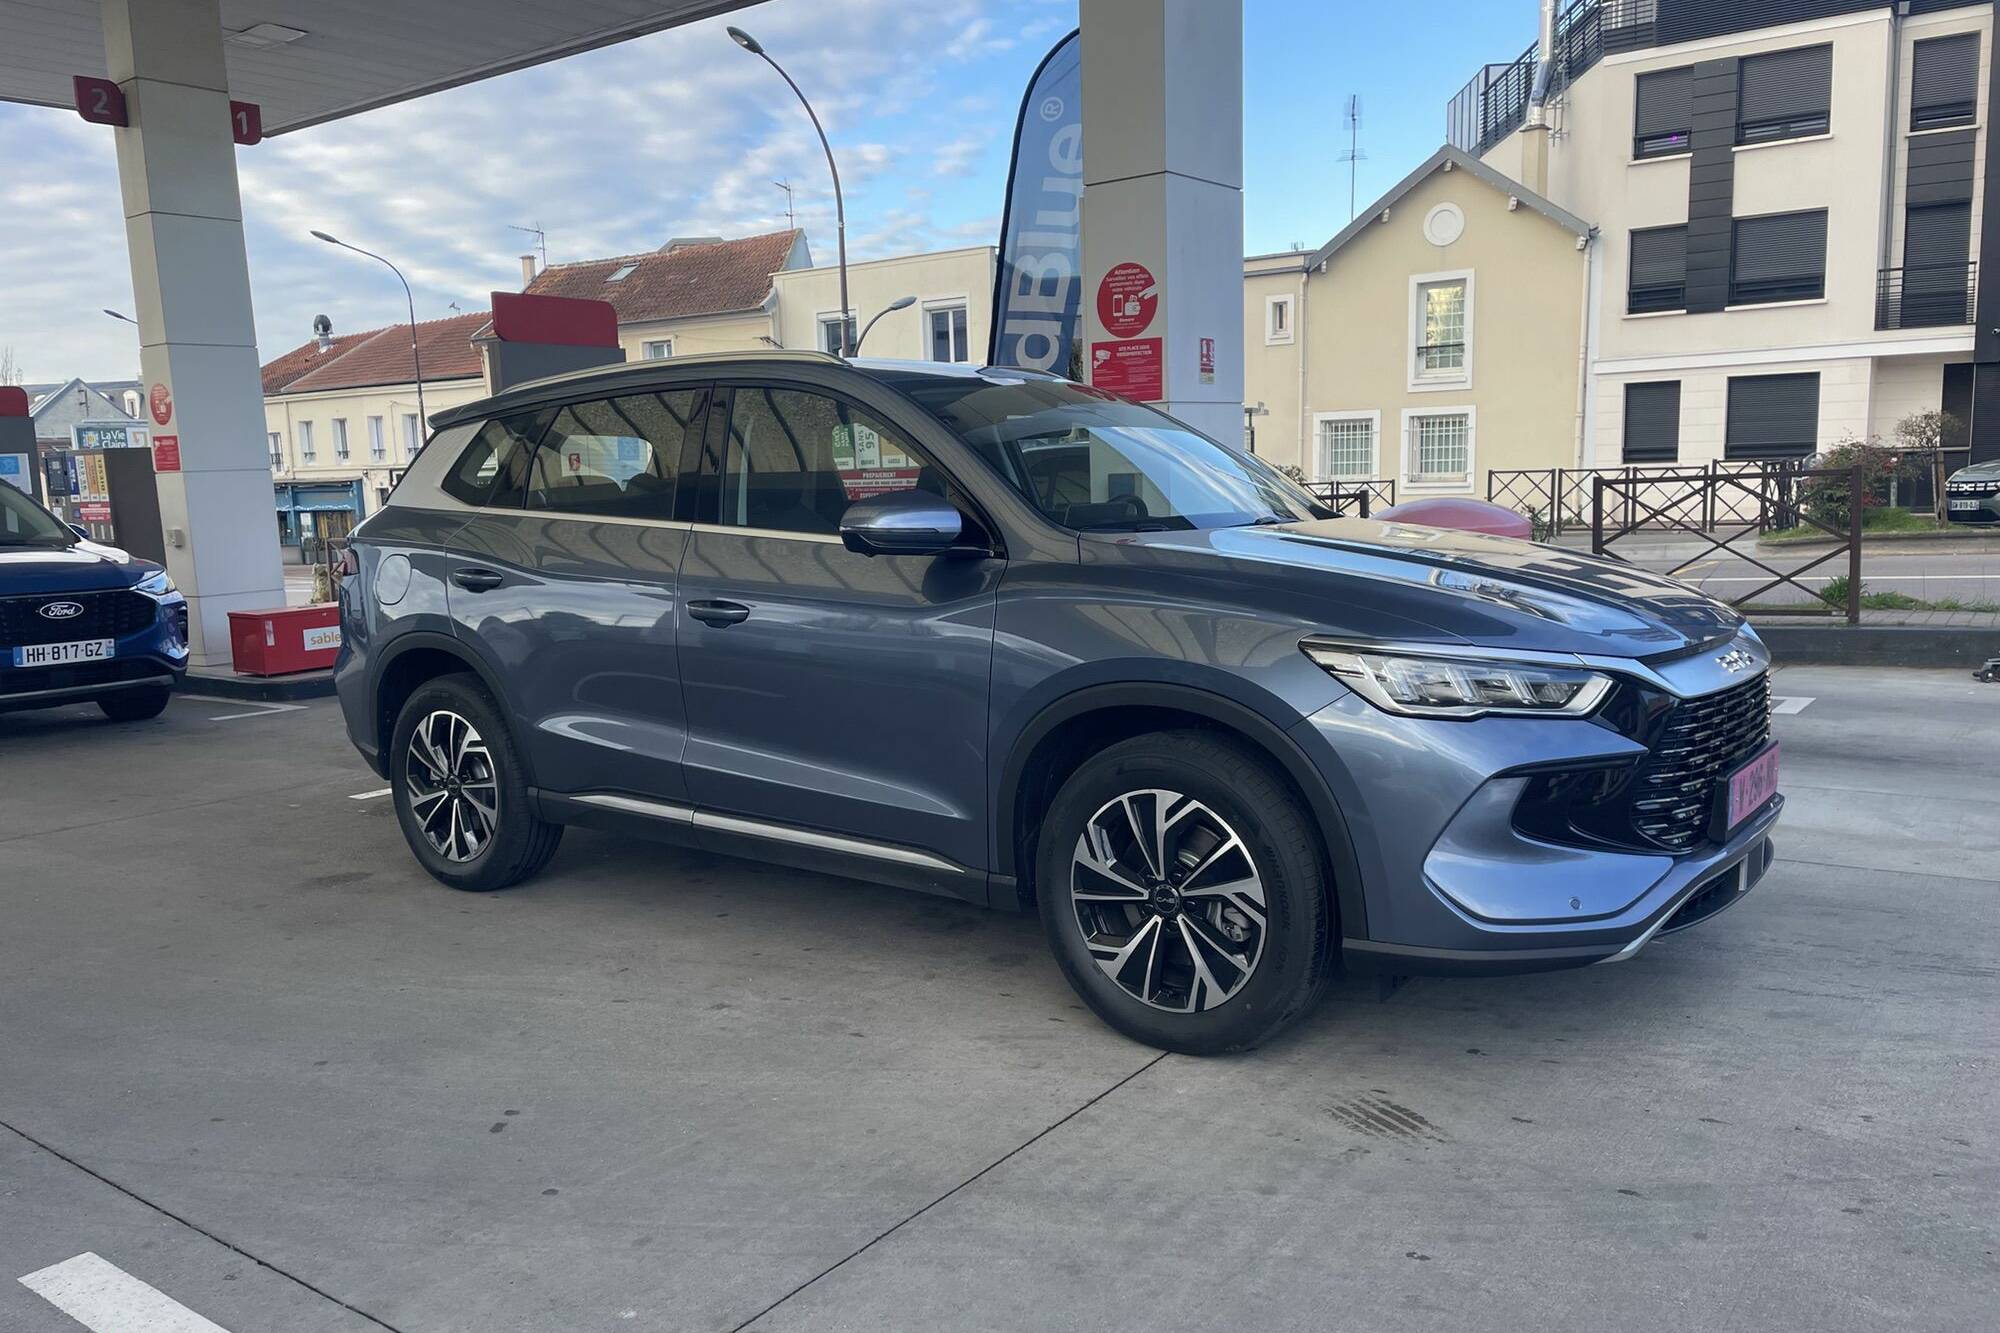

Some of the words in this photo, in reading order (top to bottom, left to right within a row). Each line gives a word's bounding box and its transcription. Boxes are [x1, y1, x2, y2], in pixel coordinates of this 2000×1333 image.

[91, 87, 112, 115] 2
[236, 111, 249, 136] 1
[865, 432, 875, 449] 95
[48, 604, 76, 616] Ford
[310, 631, 341, 646] sable
[26, 642, 103, 663] HH-817-GZ
